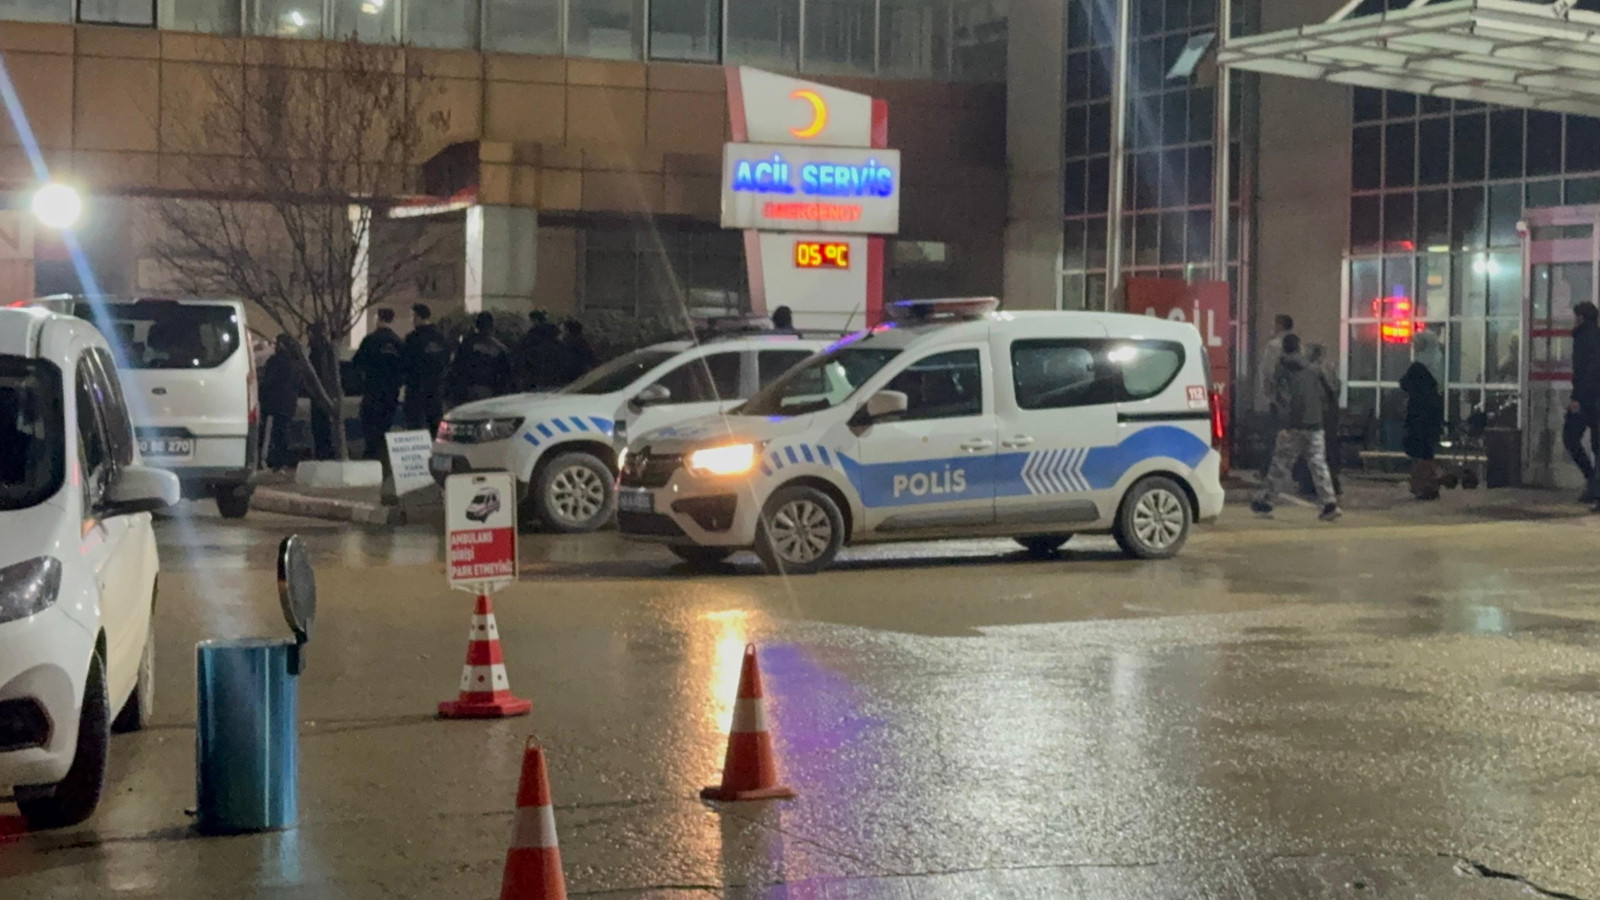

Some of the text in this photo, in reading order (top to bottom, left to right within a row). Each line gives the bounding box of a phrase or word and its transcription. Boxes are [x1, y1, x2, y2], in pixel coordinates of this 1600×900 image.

[732, 154, 893, 197] ACİL SERVİS
[168, 439, 189, 452] 270
[893, 463, 967, 498] POLİS
[451, 530, 494, 545] AMBULANS
